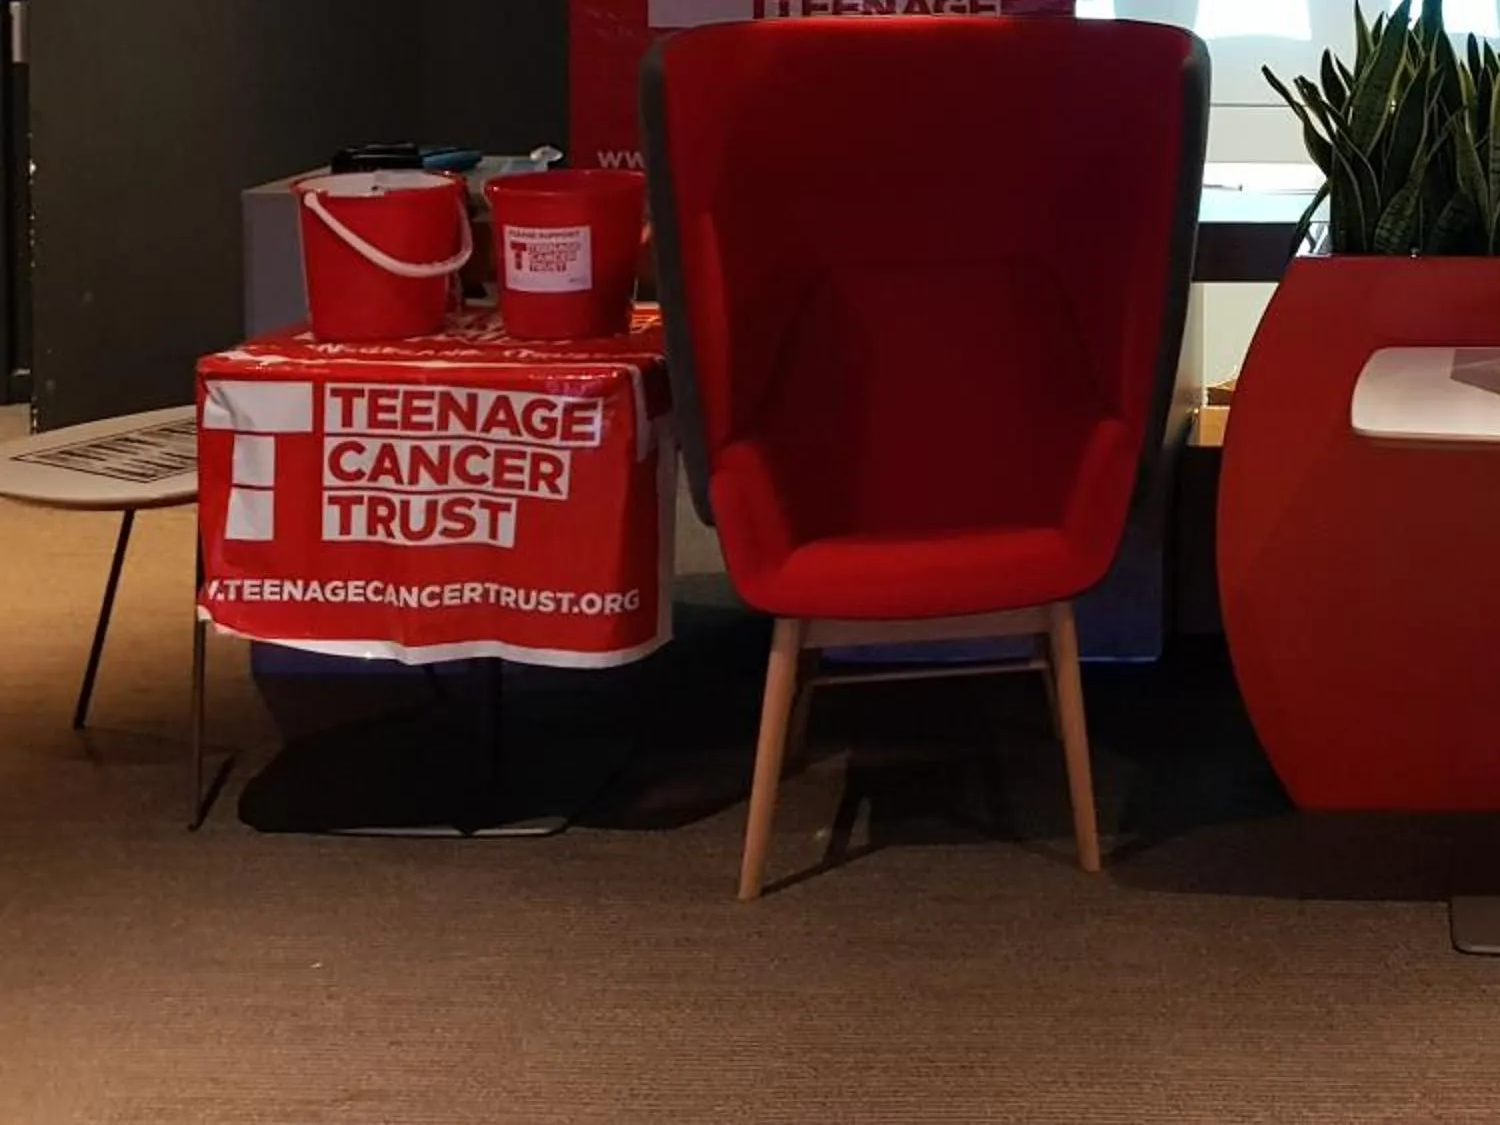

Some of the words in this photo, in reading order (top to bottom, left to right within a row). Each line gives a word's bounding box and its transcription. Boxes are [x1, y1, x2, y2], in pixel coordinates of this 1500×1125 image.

[329, 387, 599, 443] TEENAGE
[327, 440, 564, 495] CANCER
[327, 494, 512, 542] TRUST
